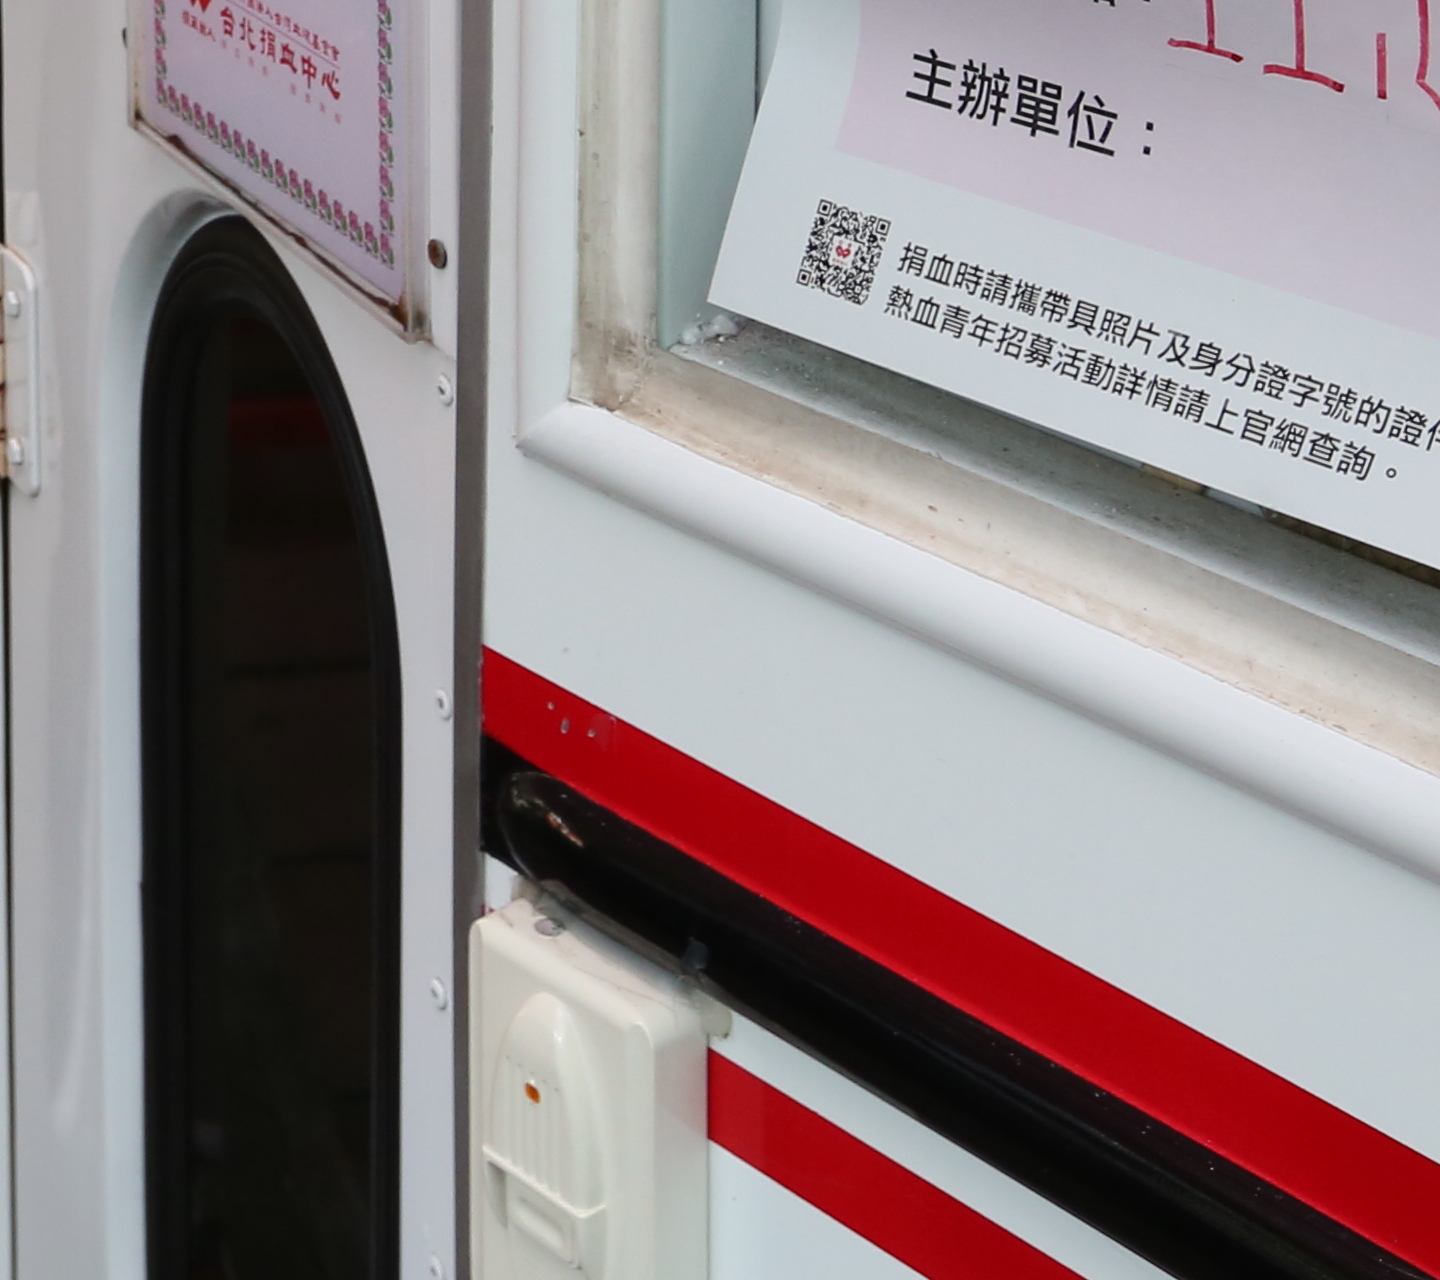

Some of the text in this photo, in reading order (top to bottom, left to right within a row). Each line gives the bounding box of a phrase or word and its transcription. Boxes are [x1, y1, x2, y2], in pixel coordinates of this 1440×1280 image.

[219, 6, 342, 101] 台北捐血中心
[903, 49, 1156, 159] 主辦單位：
